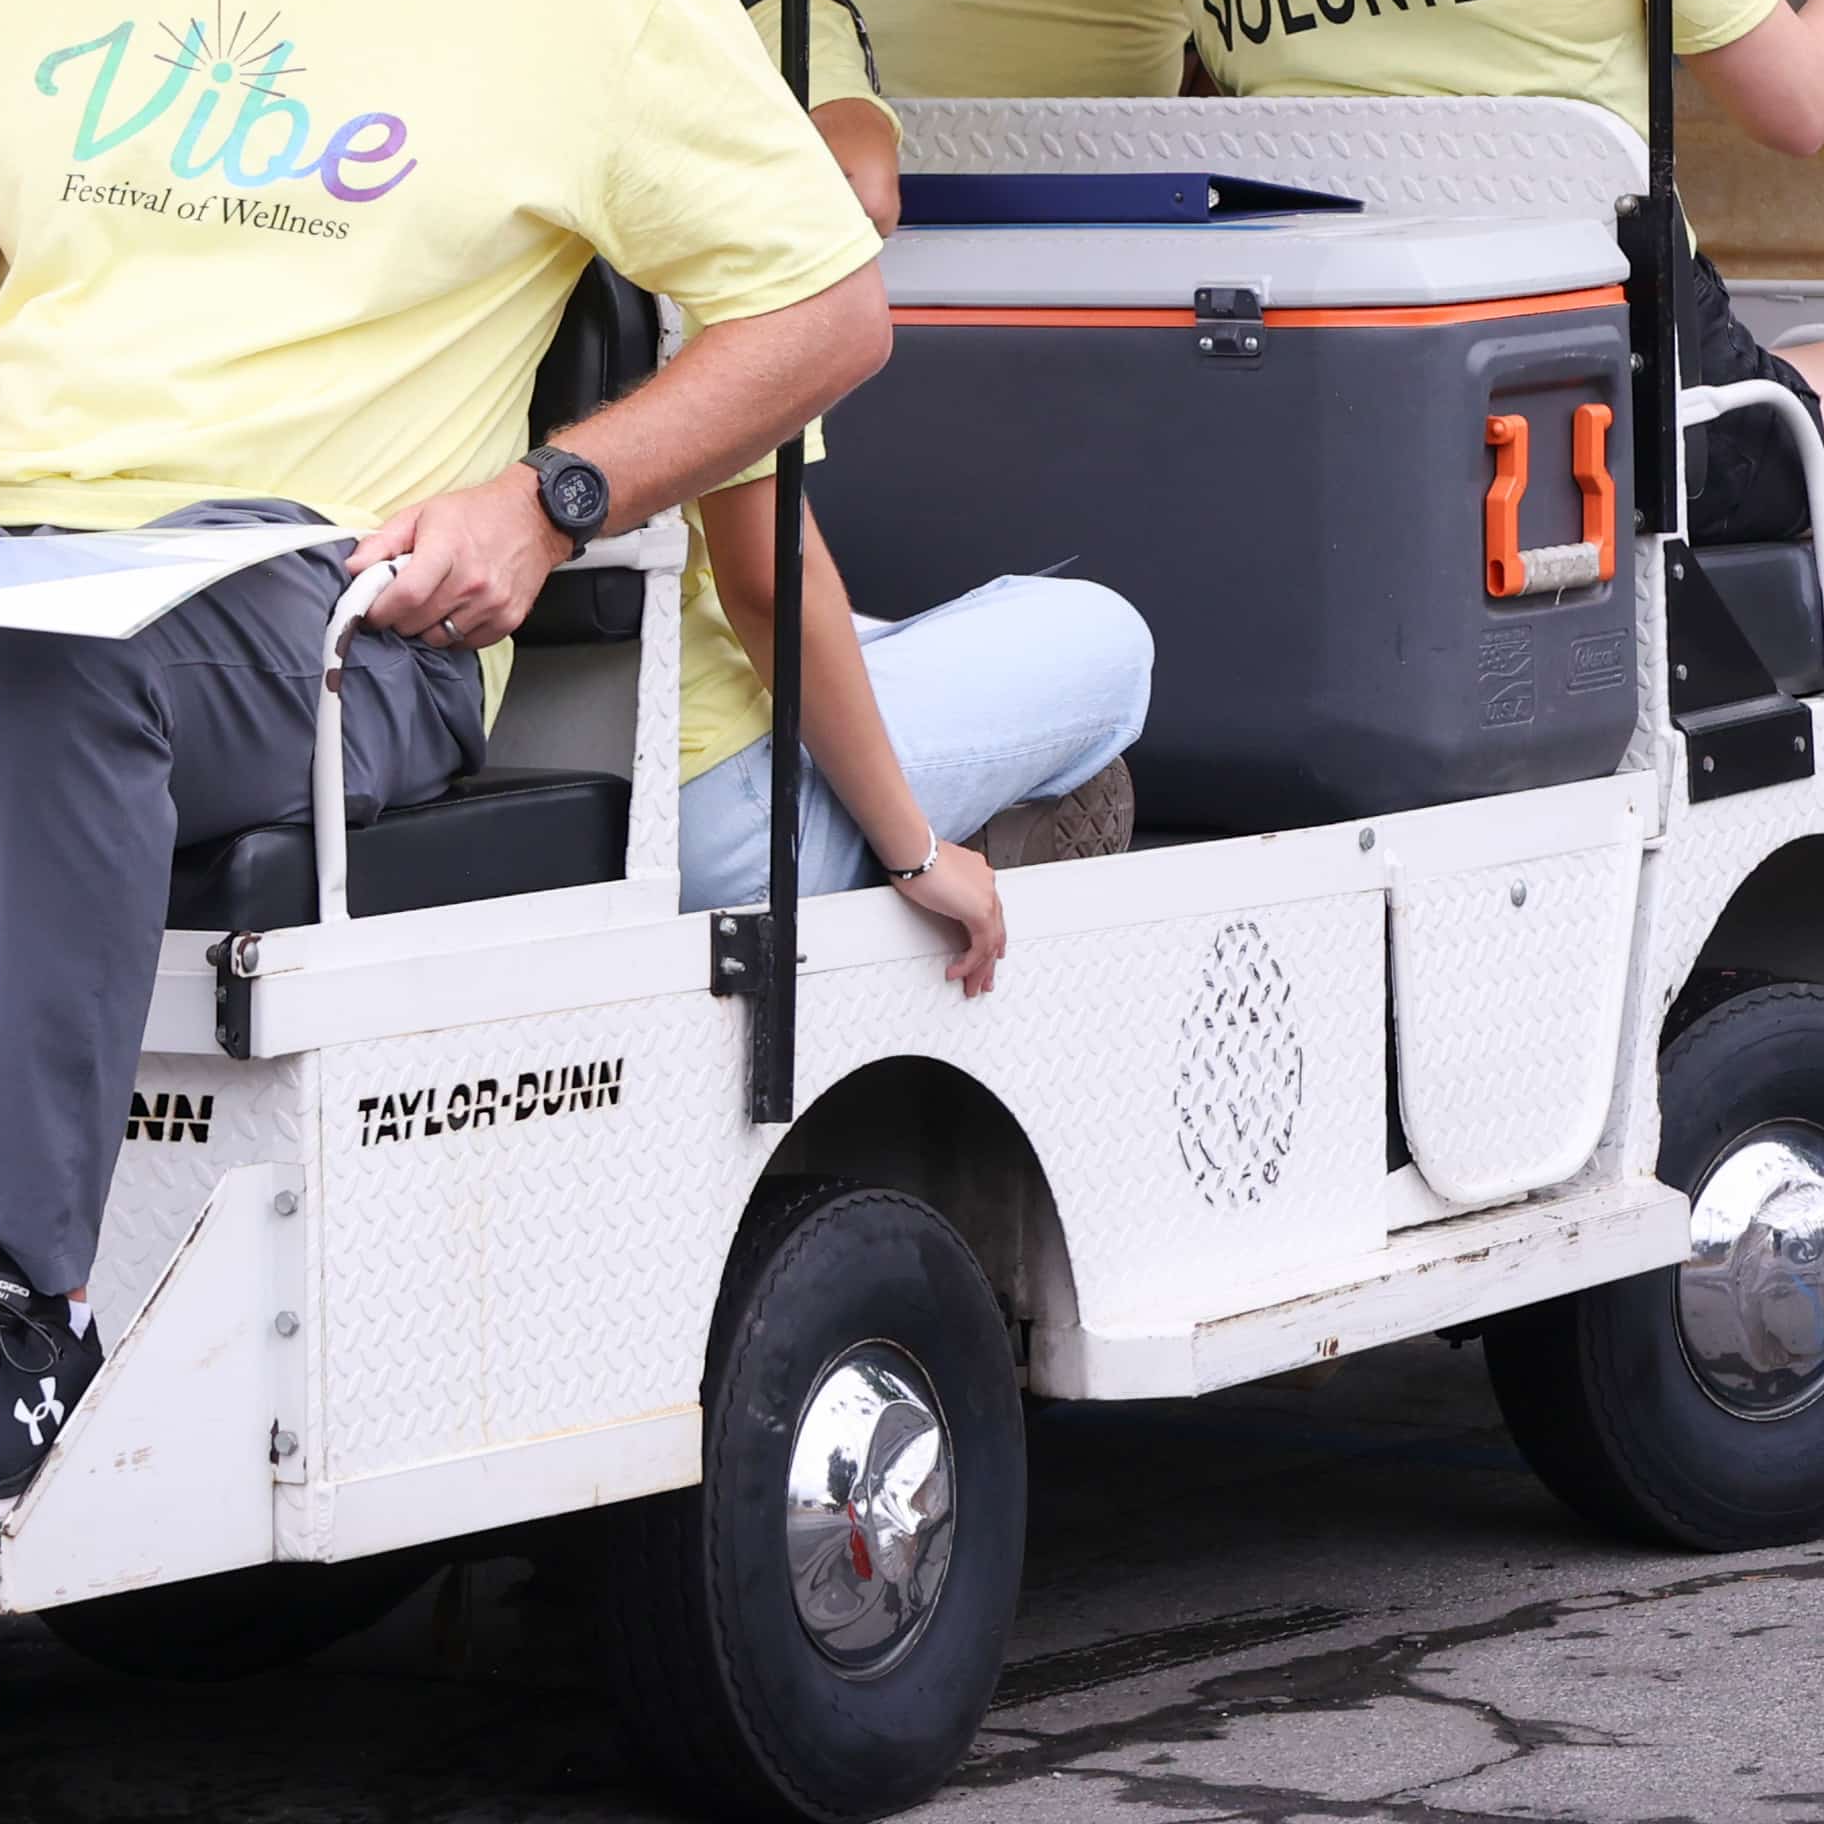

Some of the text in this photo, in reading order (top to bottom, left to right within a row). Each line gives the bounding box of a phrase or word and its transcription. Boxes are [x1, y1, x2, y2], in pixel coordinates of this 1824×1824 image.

[35, 20, 418, 203] Vibe
[58, 173, 351, 241] Festival of Wellness
[357, 1058, 624, 1146] TAYLOR-DUNN
